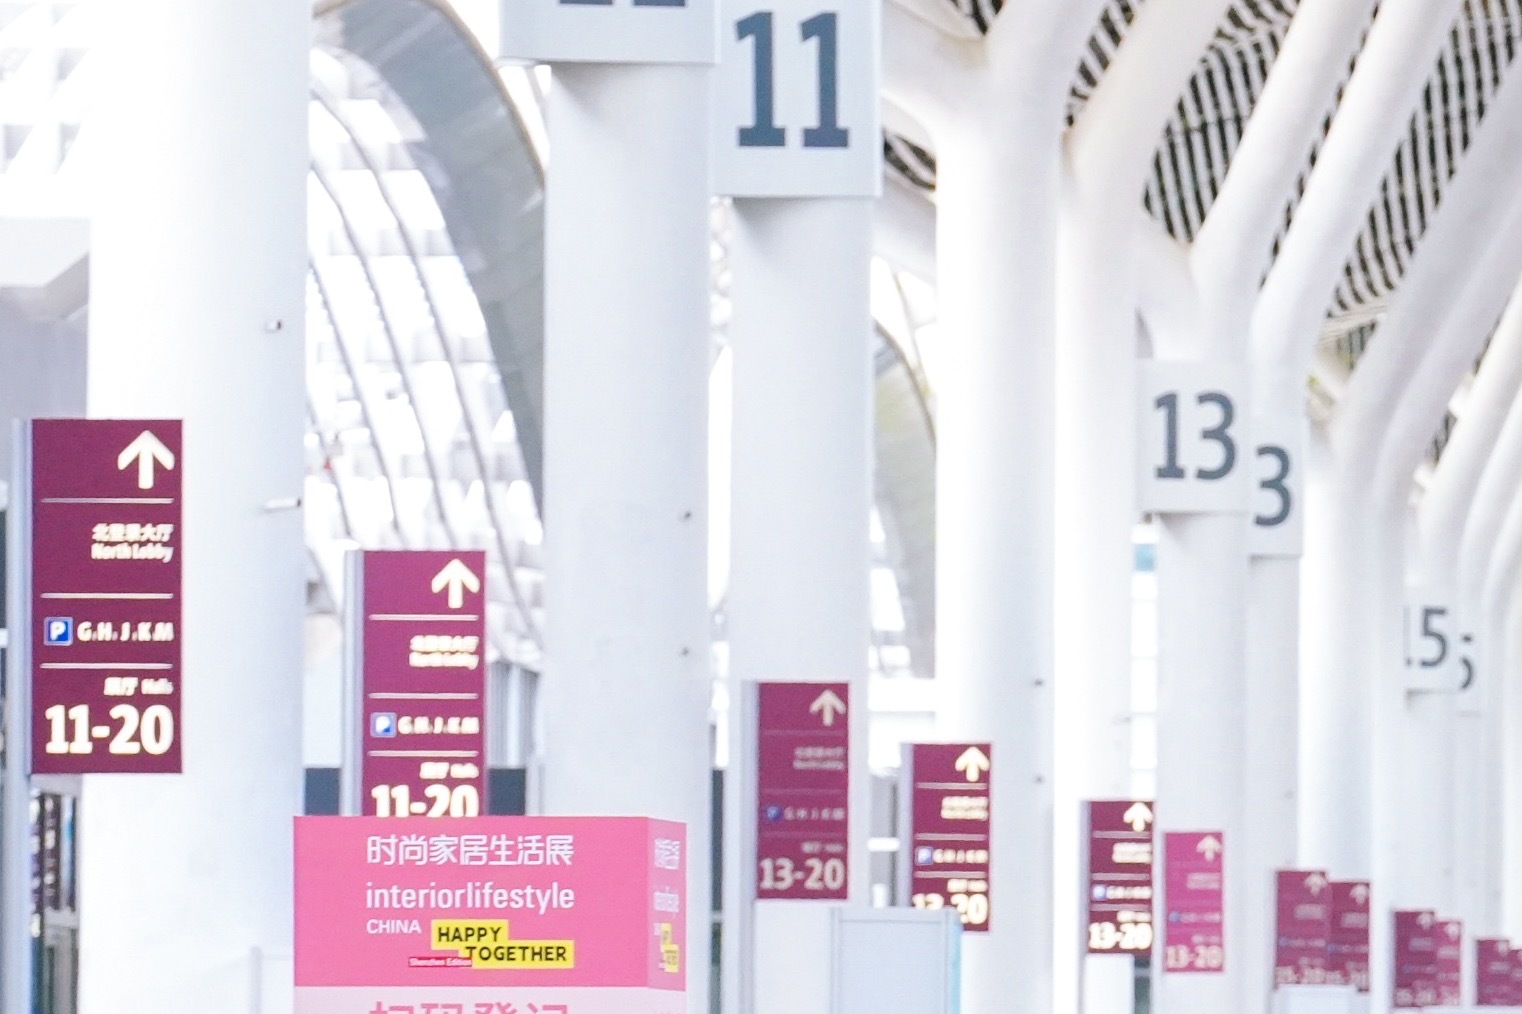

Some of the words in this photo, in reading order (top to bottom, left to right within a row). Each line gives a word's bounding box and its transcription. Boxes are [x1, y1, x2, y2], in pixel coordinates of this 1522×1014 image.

[735, 11, 848, 147] 11
[1153, 391, 1238, 480] 13
[1254, 444, 1293, 527] 3
[50, 621, 66, 641] P
[1405, 605, 1448, 668] 5
[45, 704, 174, 755] 11-20
[371, 784, 479, 818] 11-20
[366, 834, 575, 866] 时尚家居生活展
[759, 857, 845, 890] 13-20
[366, 881, 575, 914] interiorlifestyle
[366, 919, 422, 934] CHINA
[438, 927, 502, 942] HAPPY
[465, 946, 567, 961] TOGETHER
